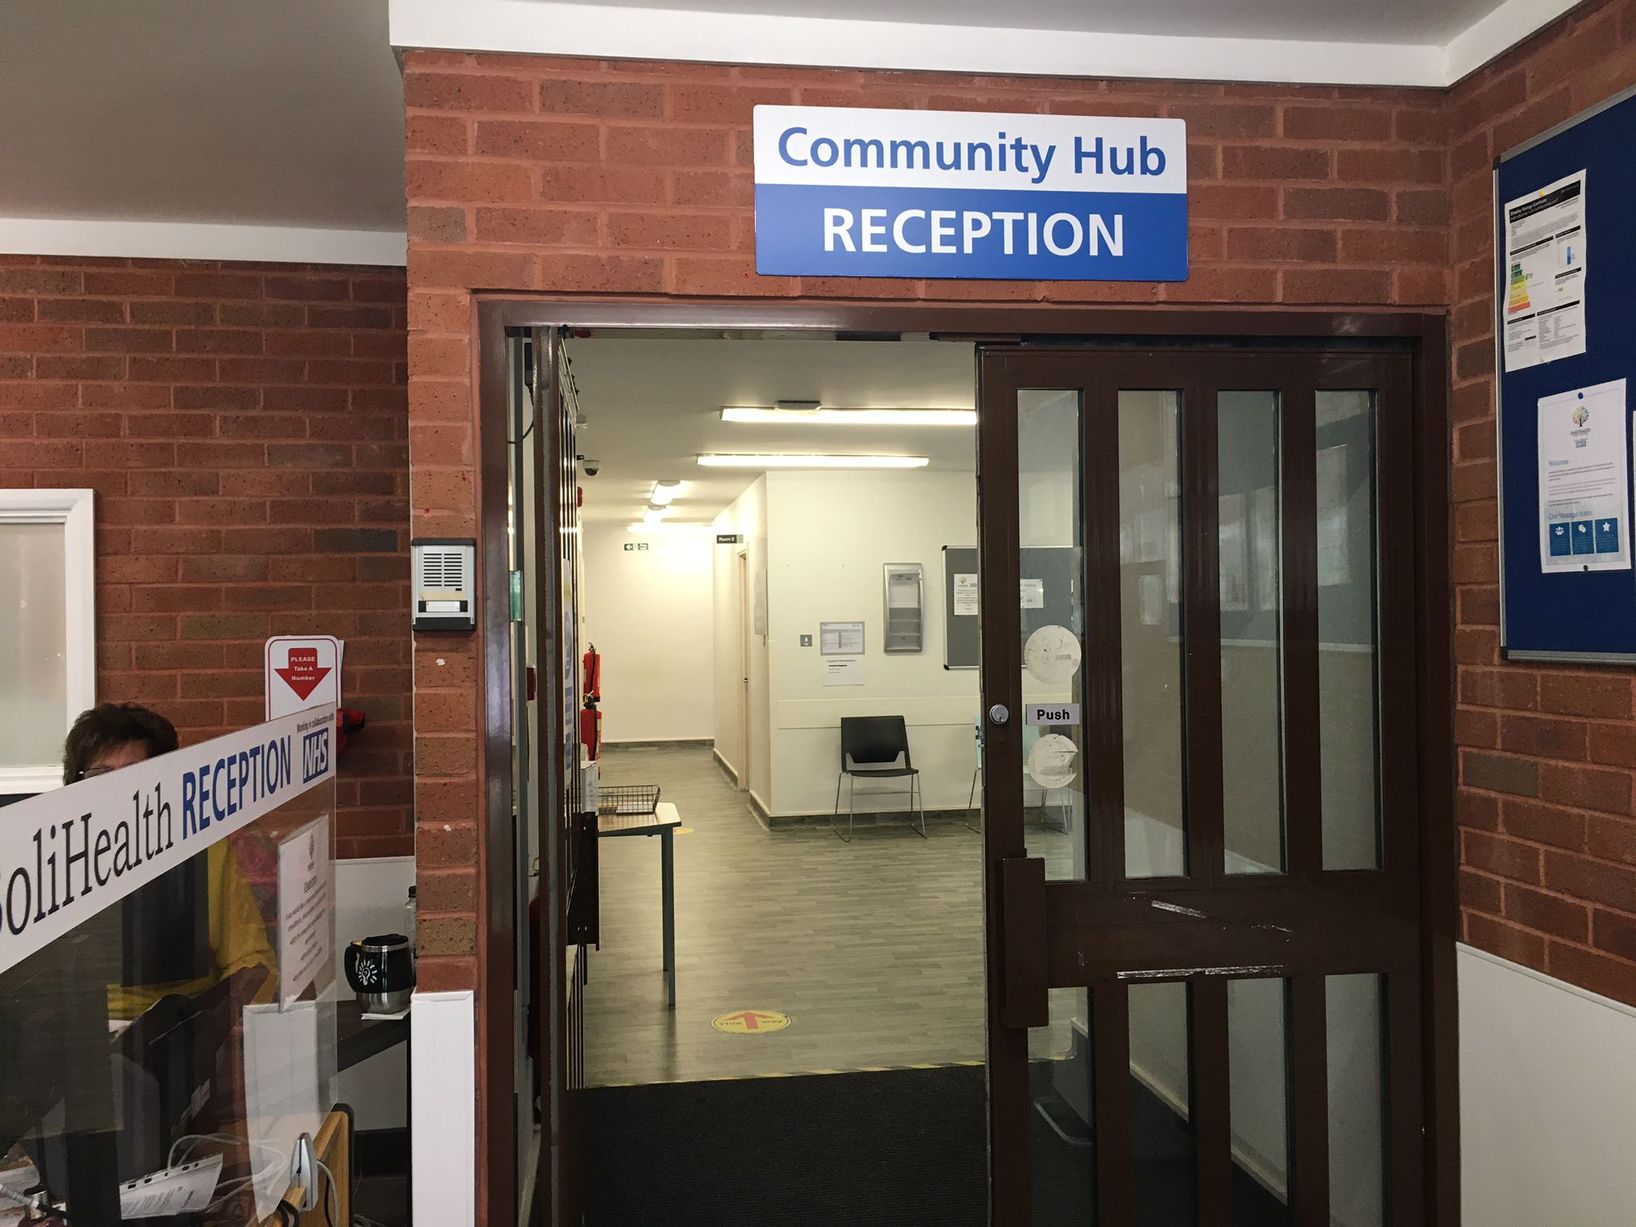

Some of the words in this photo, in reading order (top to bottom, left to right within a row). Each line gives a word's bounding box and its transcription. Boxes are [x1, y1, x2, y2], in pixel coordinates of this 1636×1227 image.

[777, 126, 1057, 184] Community
[1073, 135, 1167, 176] Hub
[822, 207, 1124, 257] RECEPTION
[1036, 709, 1070, 721] Push
[303, 731, 328, 780] NHS
[0, 782, 175, 936] oliHealth
[182, 735, 292, 841] RECEPTION
